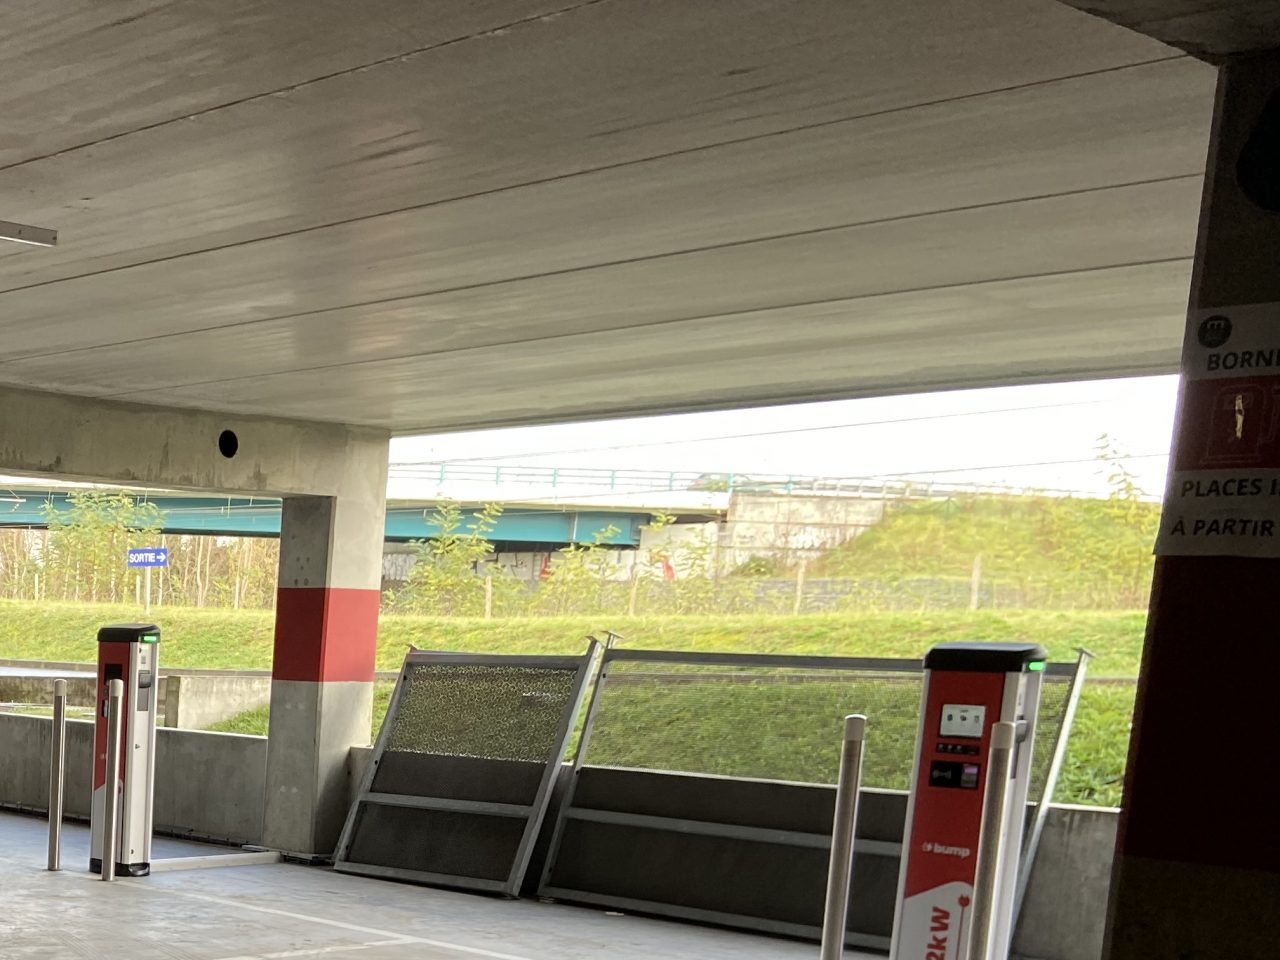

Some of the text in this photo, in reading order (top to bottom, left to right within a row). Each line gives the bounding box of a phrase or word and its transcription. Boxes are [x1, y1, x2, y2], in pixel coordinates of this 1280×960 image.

[1181, 479, 1262, 498] PLACES
[1171, 516, 1274, 537] À PARTIR
[129, 552, 156, 563] SORTIE
[933, 843, 970, 858] bump
